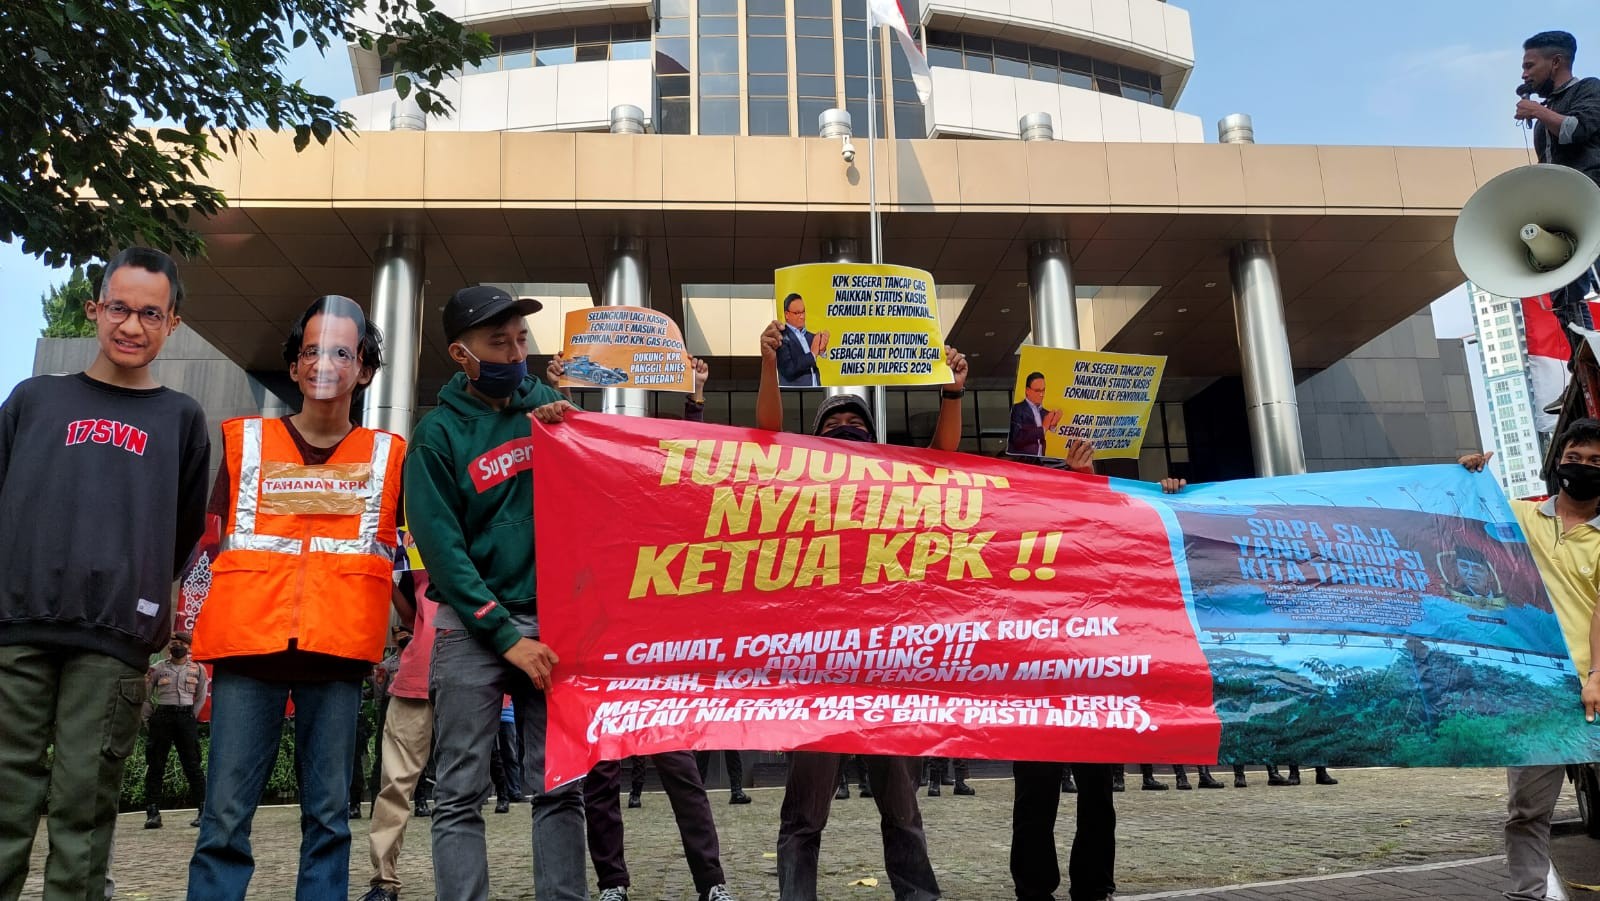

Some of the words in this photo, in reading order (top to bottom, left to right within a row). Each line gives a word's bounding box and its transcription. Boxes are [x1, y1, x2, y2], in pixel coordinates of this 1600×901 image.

[832, 275, 849, 288] KPK
[852, 275, 882, 289] SEGERA
[884, 276, 912, 290] TANCAP
[913, 278, 926, 292] GAS
[835, 290, 872, 302] NAIKKAN
[874, 291, 903, 303] STATUS
[904, 292, 927, 305] KASUS
[827, 304, 867, 317] FORMULA
[868, 304, 874, 316] E
[875, 304, 886, 316] KE
[588, 311, 629, 321] SELANGKAH
[630, 312, 646, 323] LAGI
[647, 313, 668, 326] KASUS
[590, 322, 624, 333] FORMULA
[631, 323, 656, 334] MASUK
[657, 326, 667, 336] KE
[614, 334, 629, 344] AYO
[630, 335, 645, 345] KPK
[646, 336, 661, 346] GAS
[841, 333, 865, 346] AGAR
[867, 333, 891, 345] TIDAK
[893, 333, 929, 346] DITUDING
[633, 352, 664, 362] DUKUNG
[666, 352, 681, 361] KPK
[830, 347, 866, 360] SEBAGAI
[867, 347, 887, 360] ALAT
[888, 347, 917, 360] POLITIK
[918, 348, 940, 360] JEGAL
[631, 363, 662, 373] PANGGIL
[664, 363, 686, 372] ANIES
[840, 361, 865, 375] ANIES
[867, 362, 875, 374] DI
[877, 362, 909, 374] PILPRES
[910, 362, 932, 374] 2024
[1074, 361, 1090, 372] KPK
[1091, 363, 1118, 375] SEGERA
[634, 374, 675, 384] BASWEDAN
[1064, 387, 1100, 400] FORMULA
[1072, 414, 1094, 426] AGAR
[65, 419, 148, 456] 17SVN
[1058, 425, 1092, 438] SEBAGAI
[265, 480, 334, 491] TAHANAN
[339, 480, 368, 490] KPK
[704, 484, 983, 538] NYALIMU
[1247, 517, 1328, 541] SIAPA
[1333, 523, 1399, 548] SAJA
[1232, 535, 1311, 562] YANG
[1316, 540, 1425, 571] KORUPSI
[628, 534, 841, 600] KETUA
[861, 530, 997, 585] KPK
[1009, 531, 1064, 582] !!
[1238, 557, 1306, 583] KITA
[1310, 562, 1431, 592] TANGKAP
[625, 638, 726, 665] GAWAT,
[734, 628, 860, 659] FORMULA
[868, 627, 885, 649] E
[890, 620, 991, 648] PROYEK
[997, 618, 1059, 641] RUGI
[1066, 616, 1120, 637] GAK
[765, 653, 817, 670] ADA
[826, 645, 934, 670] UNTUNG
[939, 643, 976, 667] !!!
[714, 667, 771, 690] KOK
[865, 663, 1009, 683] PENONTON
[1012, 654, 1151, 681] MENYUSUT
[595, 697, 730, 719] MASALAH
[810, 694, 939, 710] MASALAH
[1060, 695, 1141, 712] TERUS
[587, 707, 689, 744] (KALAU
[695, 706, 810, 723] NIATNYA
[863, 708, 885, 723] G
[892, 707, 957, 724] BAIK
[963, 707, 1040, 725] PASTI
[1044, 708, 1098, 728] ADA
